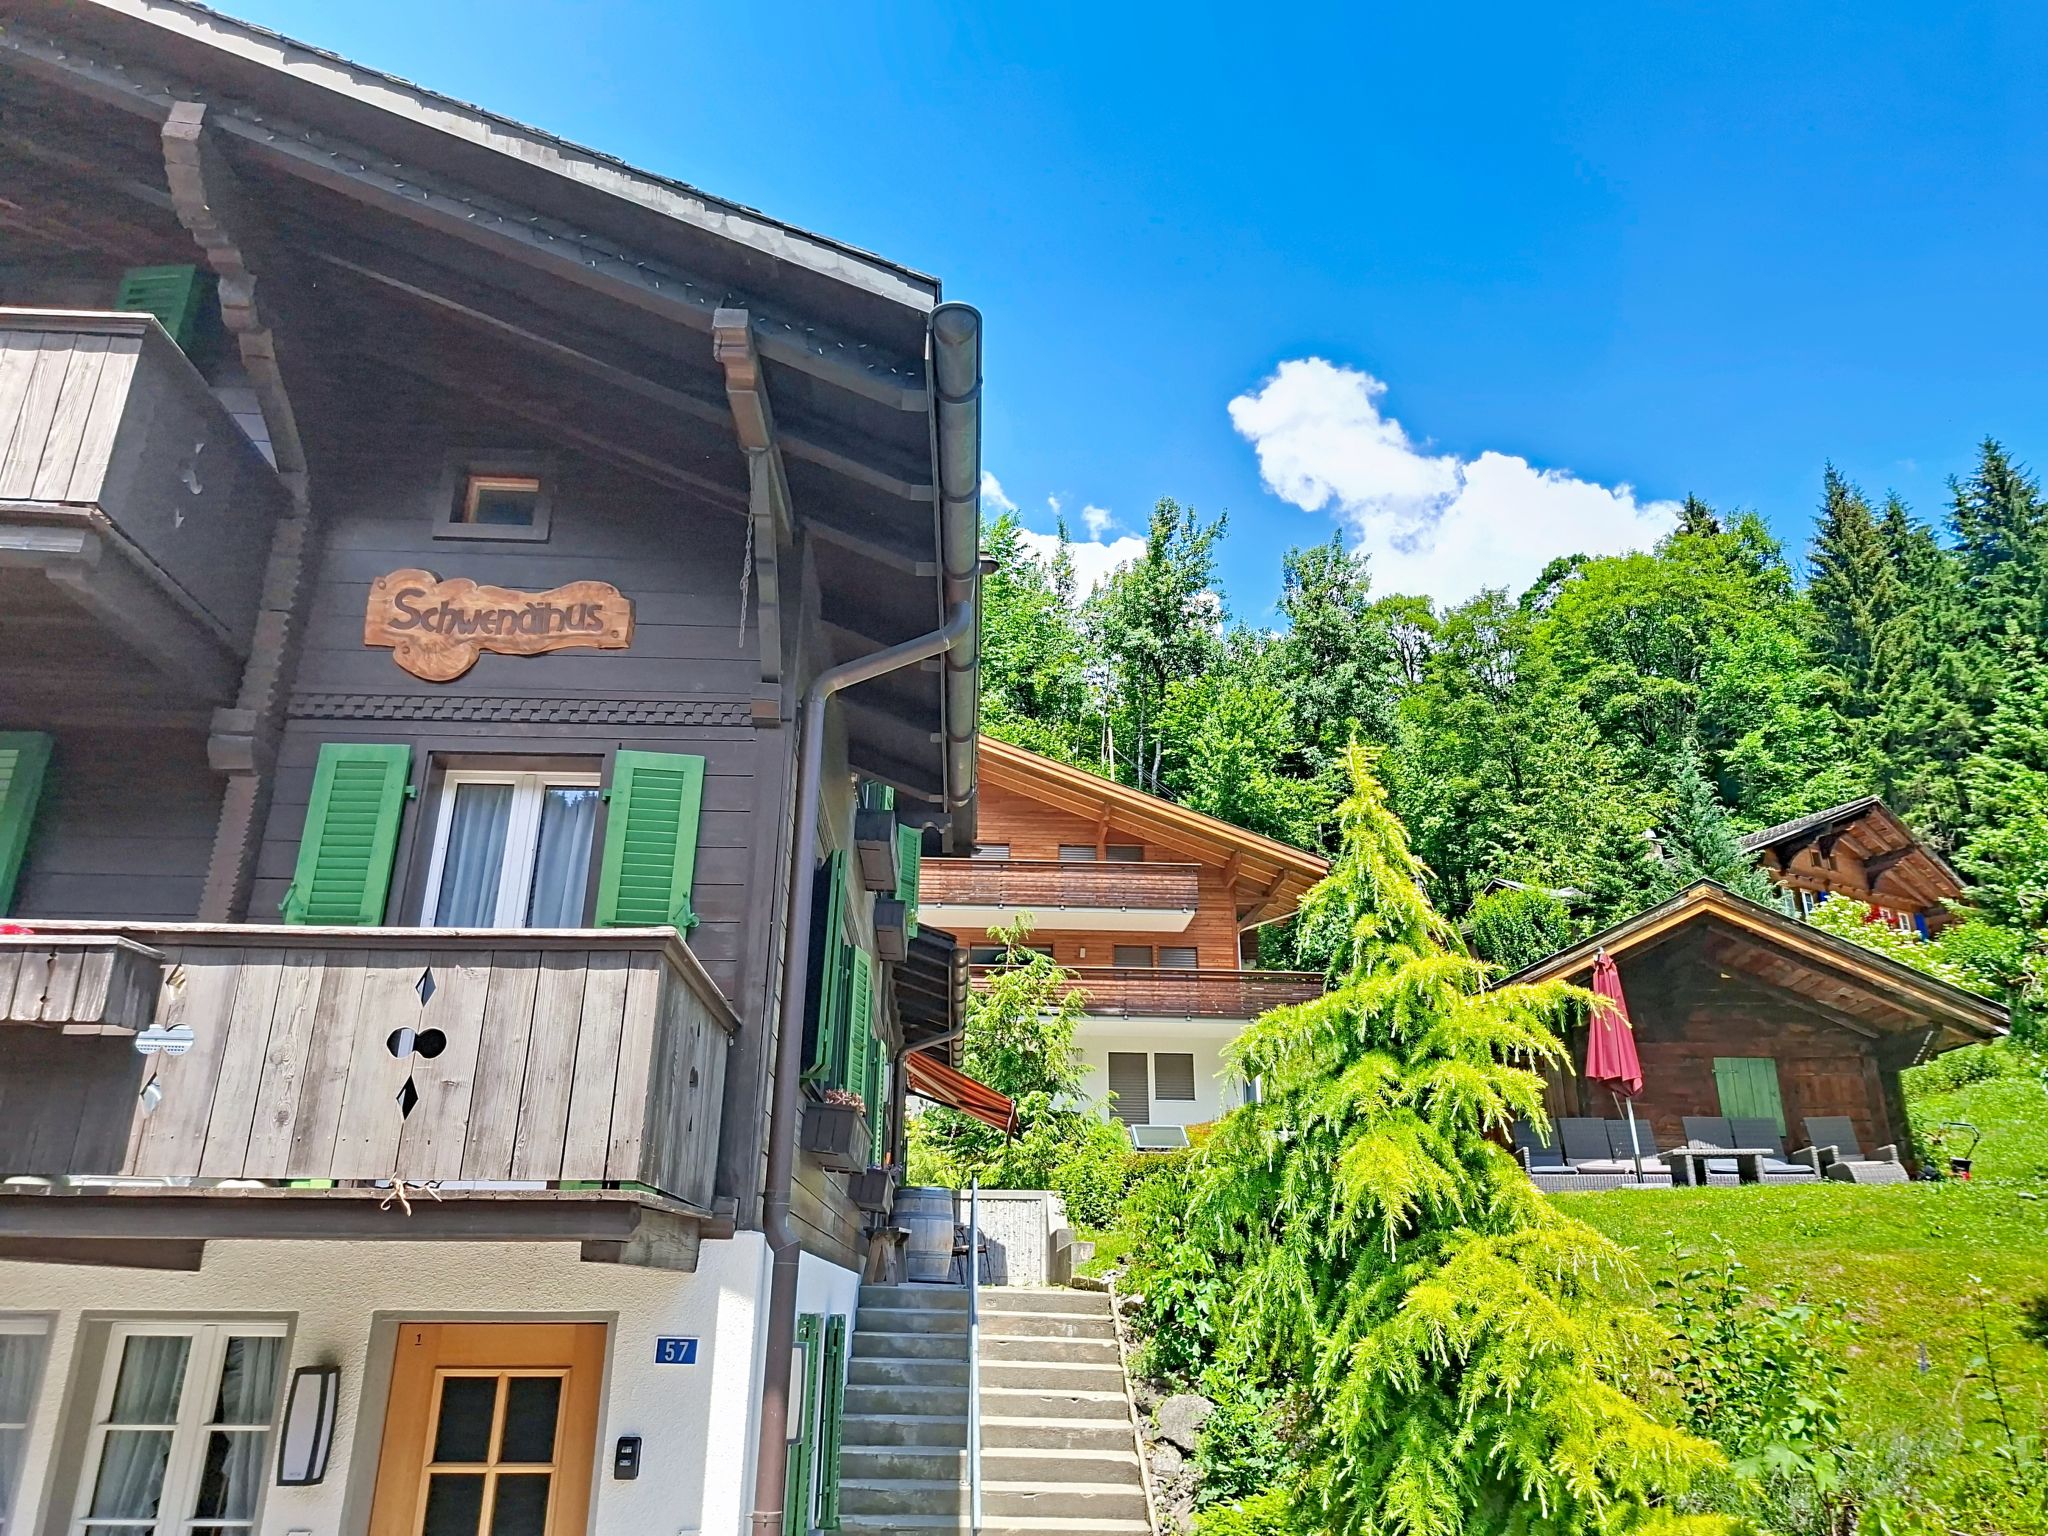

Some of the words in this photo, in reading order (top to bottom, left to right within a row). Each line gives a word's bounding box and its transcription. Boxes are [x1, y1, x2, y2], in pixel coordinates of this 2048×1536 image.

[387, 586, 604, 636] Schwendihus
[415, 1332, 422, 1345] 1
[664, 1341, 690, 1362] 57
